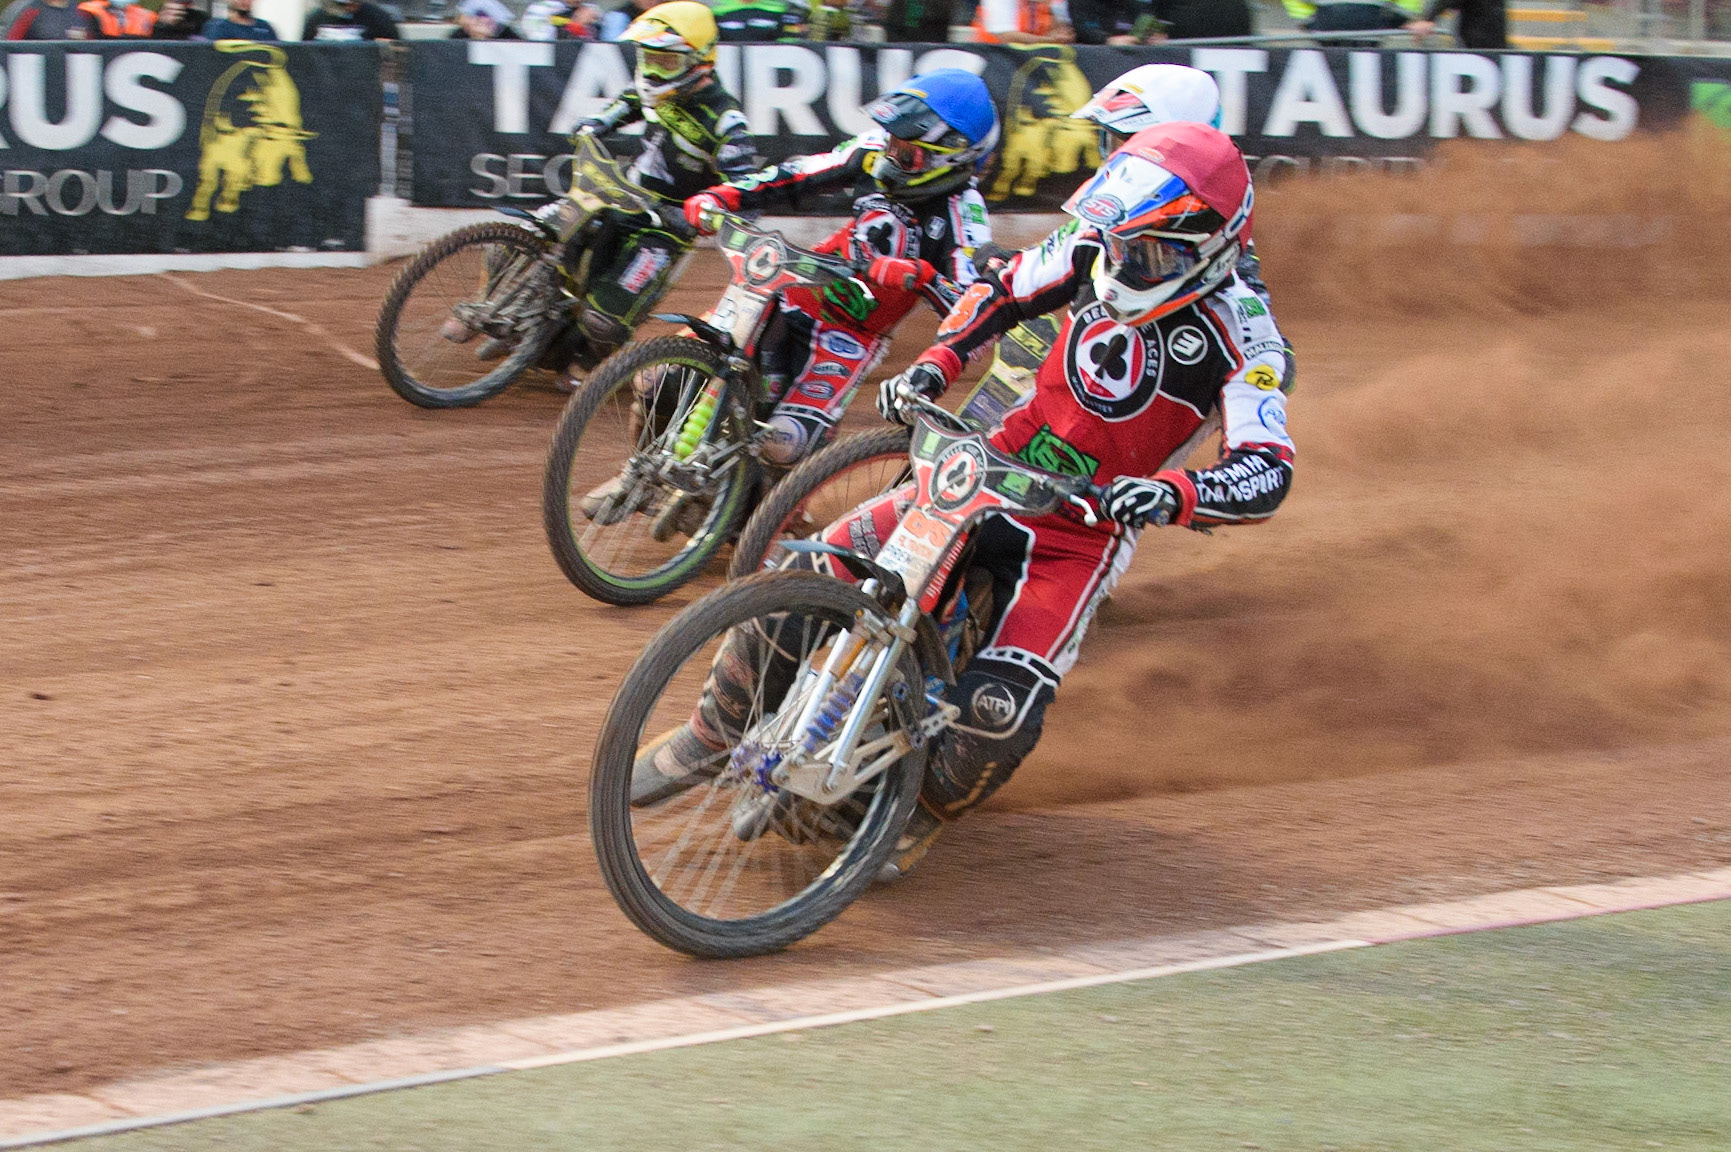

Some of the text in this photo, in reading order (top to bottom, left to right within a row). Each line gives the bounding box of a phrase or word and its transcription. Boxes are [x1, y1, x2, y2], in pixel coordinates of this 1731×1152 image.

[0, 51, 187, 150] US
[1192, 48, 1641, 142] TAURUS
[0, 168, 183, 218] ROUP
[1145, 339, 1160, 378] ACES
